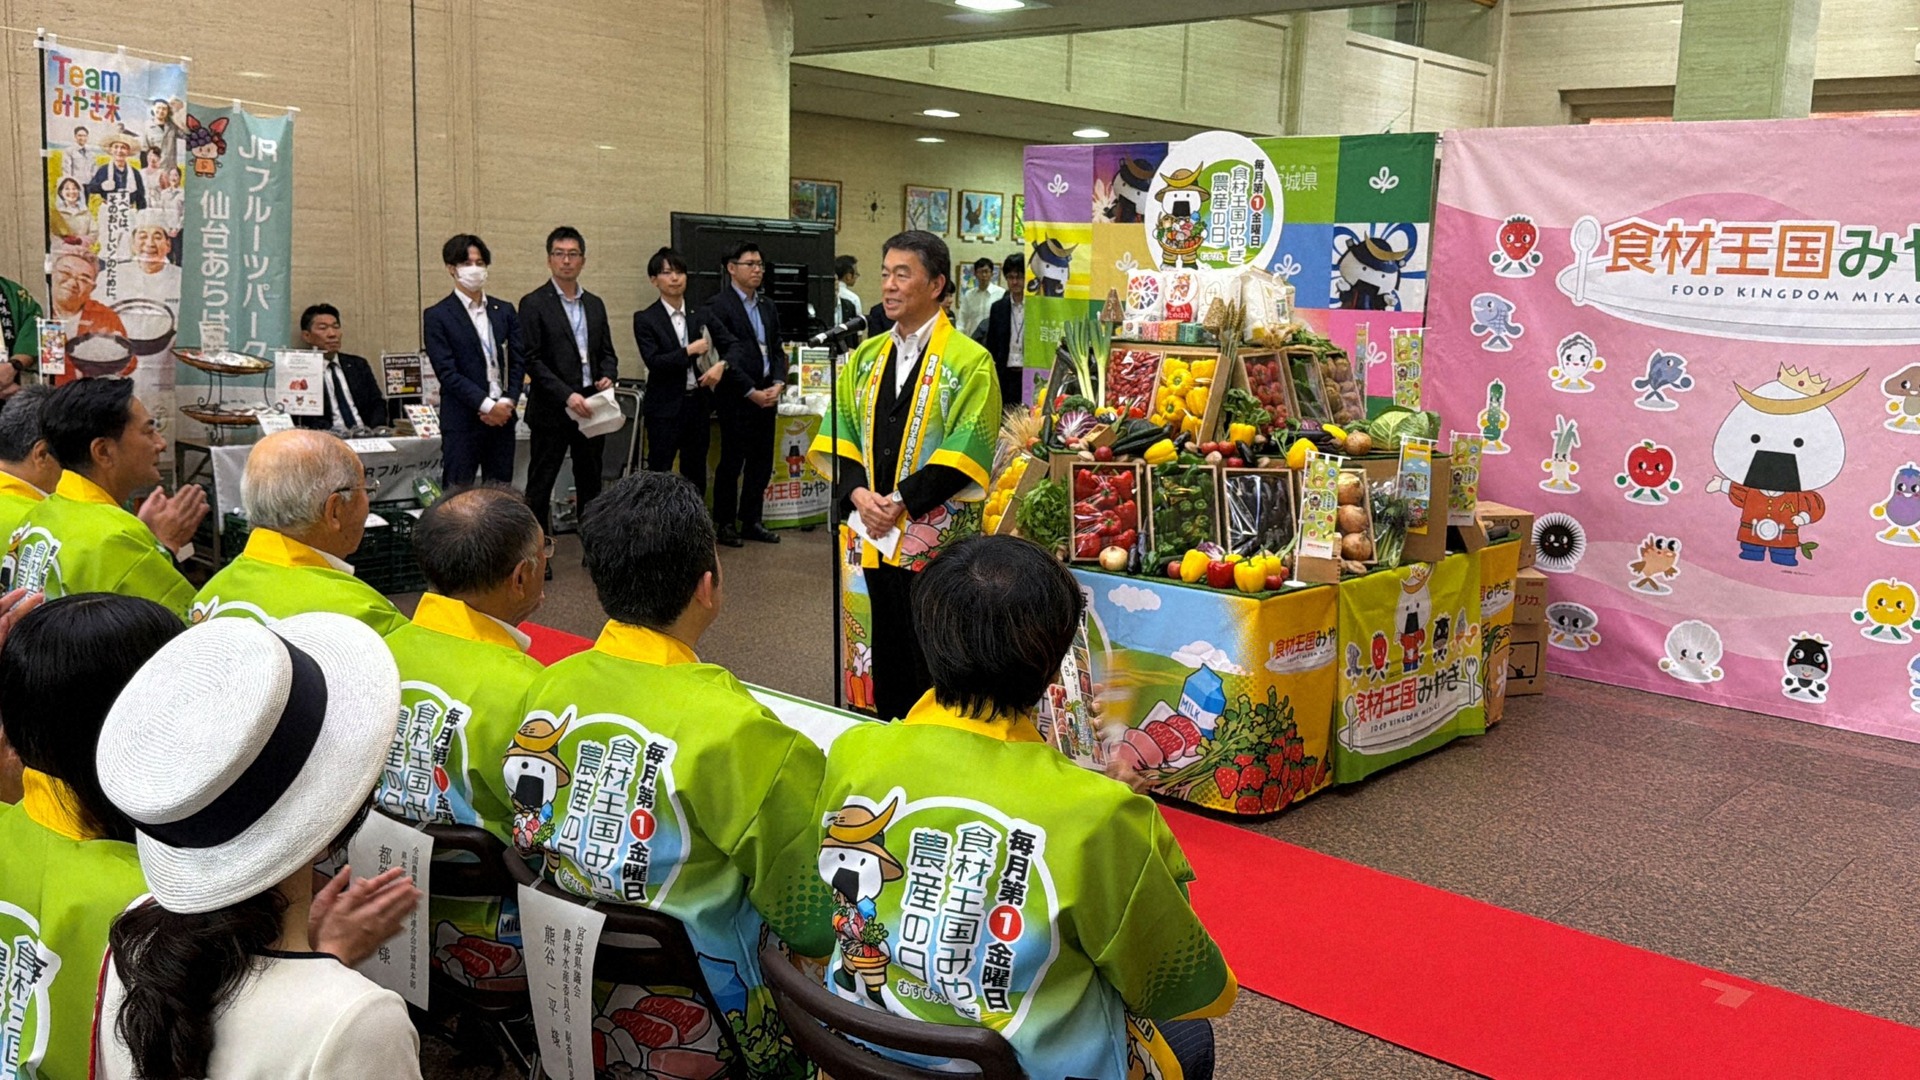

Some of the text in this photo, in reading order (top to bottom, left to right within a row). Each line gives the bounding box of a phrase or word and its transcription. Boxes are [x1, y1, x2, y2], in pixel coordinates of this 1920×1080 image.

[52, 55, 121, 93] Team
[52, 87, 121, 123] みやぎ米
[238, 134, 278, 359] JRフルーツパーク
[1211, 174, 1229, 244] 農産の日
[1229, 167, 1247, 263] 食材王国みやぎ
[1250, 159, 1265, 247] 毎月第1金曜日
[1672, 284, 1724, 297] FOOD
[1737, 286, 1839, 301] KINGDOM
[1180, 697, 1200, 721] MILK
[1356, 660, 1461, 727] 食材王国みやぎ
[585, 738, 638, 895] 食材王国みや
[623, 741, 668, 902] 毎月第1金曜日
[899, 832, 947, 984] 農産の日
[981, 829, 1036, 1012] 毎月第1金曜日
[543, 924, 557, 967] 熊谷
[550, 1027, 562, 1049] 様
[573, 926, 588, 999] 宮城県議会
